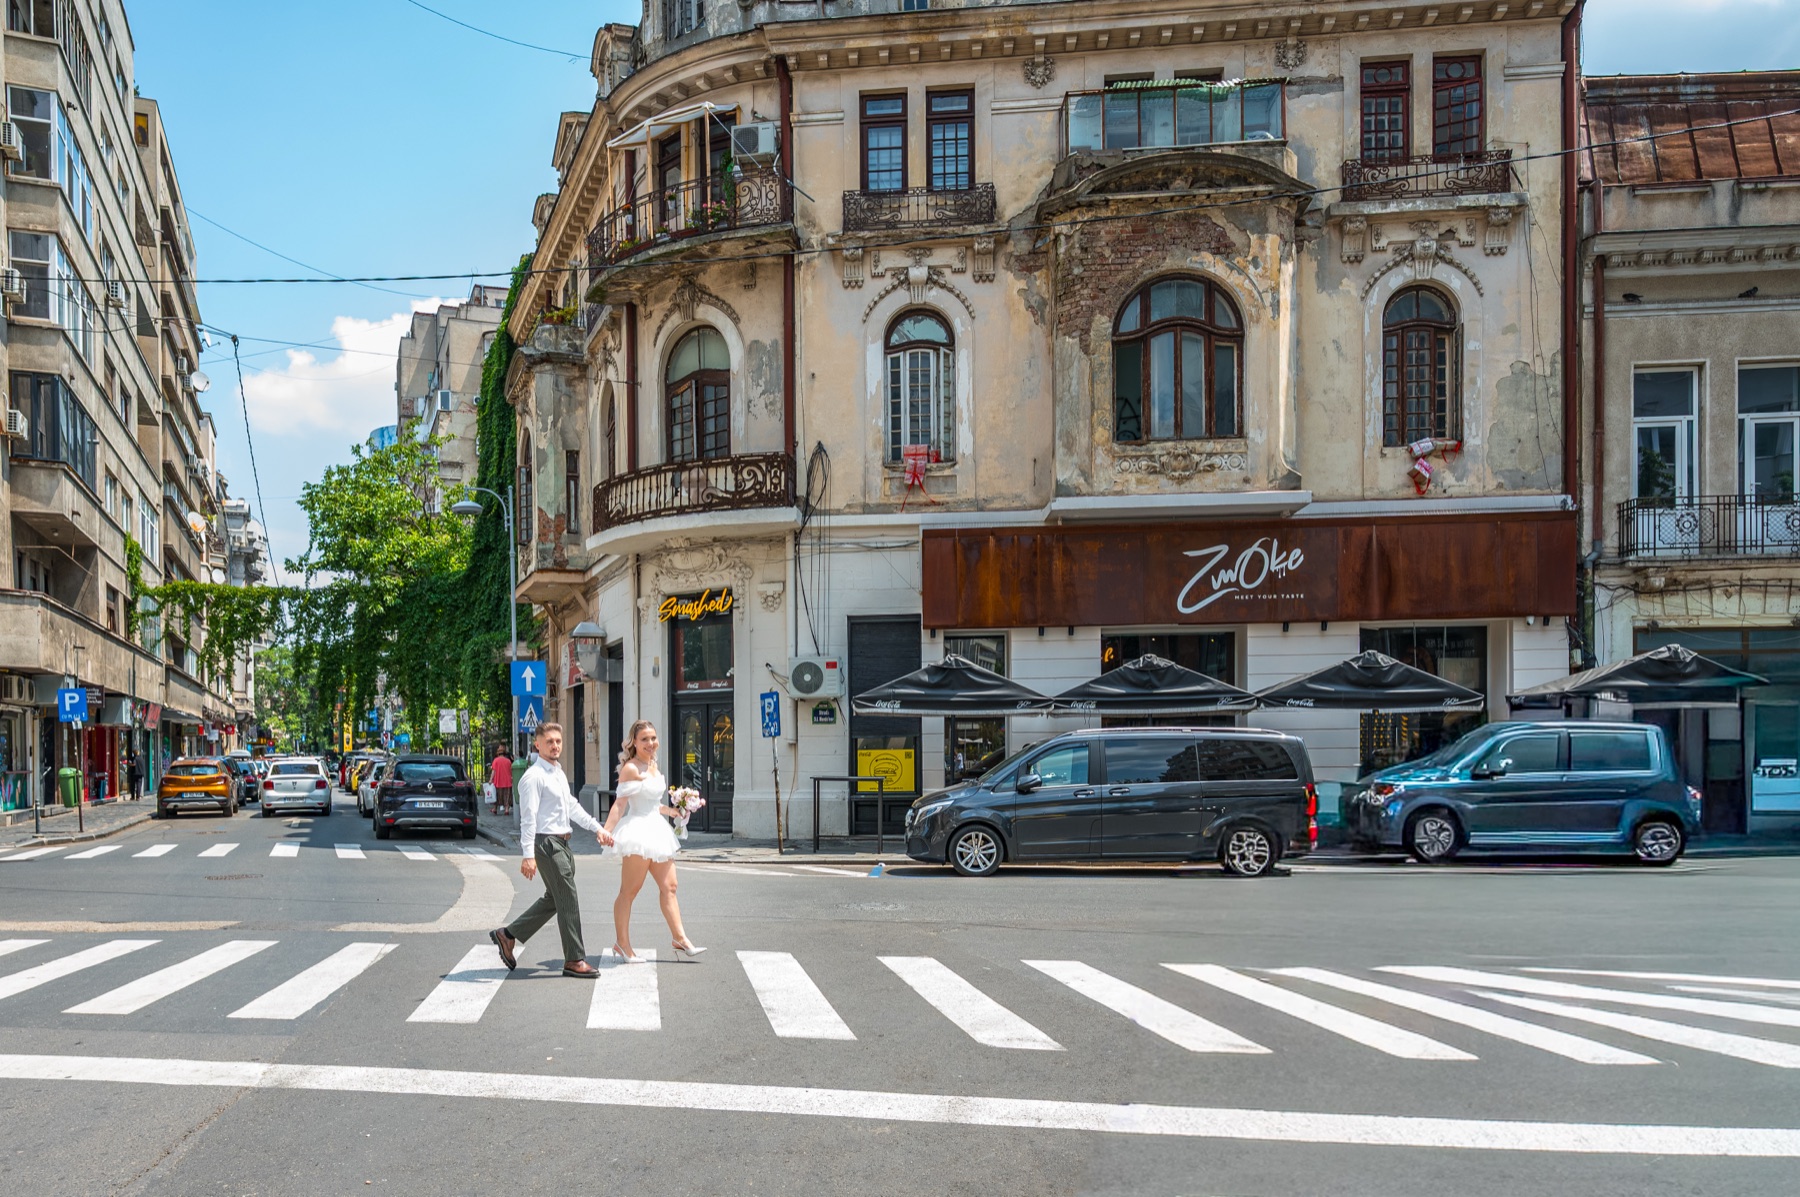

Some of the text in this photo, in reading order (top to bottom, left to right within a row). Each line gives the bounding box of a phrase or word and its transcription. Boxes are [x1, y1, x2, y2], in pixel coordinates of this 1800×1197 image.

[658, 587, 733, 622] Smashed
[64, 692, 80, 711] P
[765, 697, 774, 722] P
